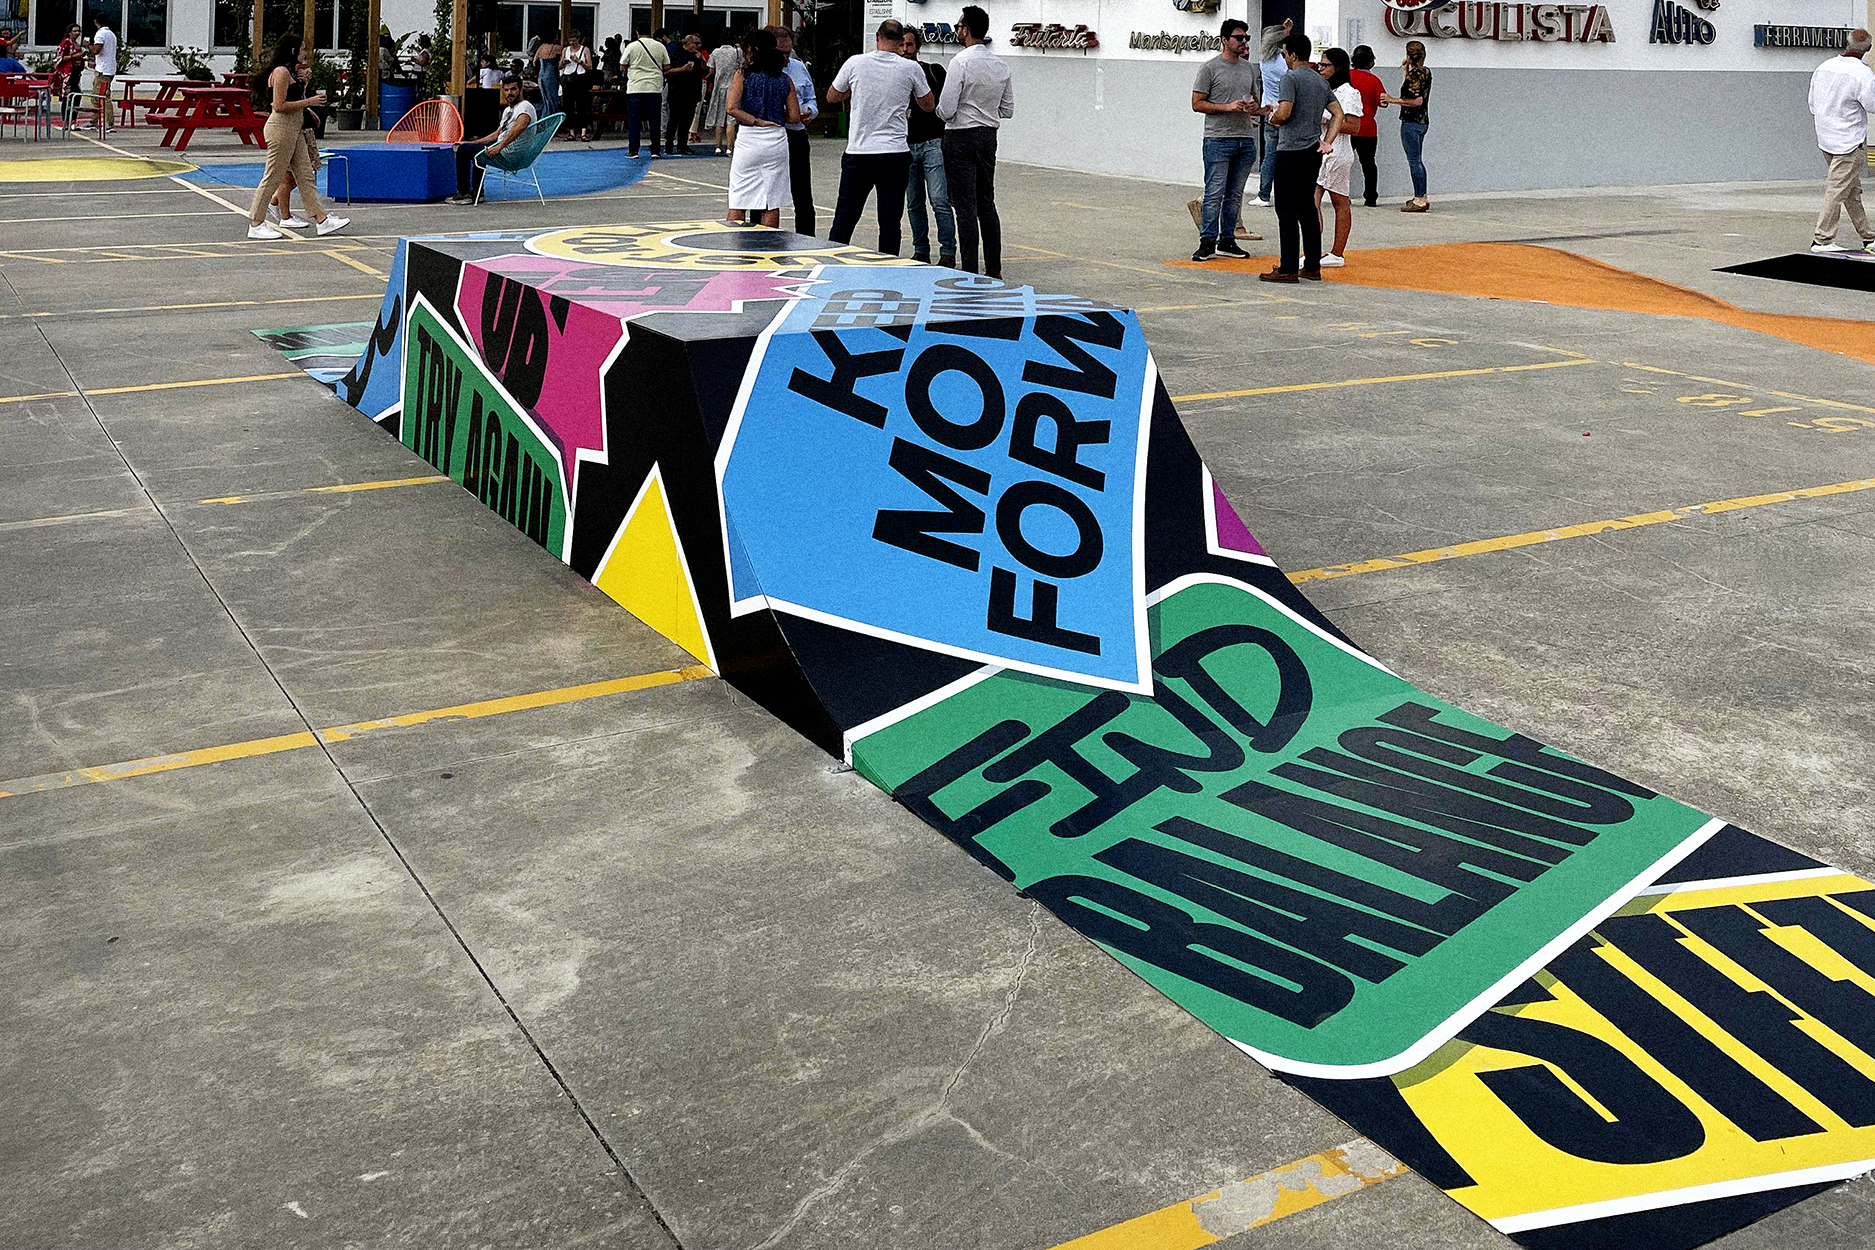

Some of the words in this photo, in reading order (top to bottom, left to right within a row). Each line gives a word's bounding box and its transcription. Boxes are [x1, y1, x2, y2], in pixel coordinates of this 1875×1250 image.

[1385, 0, 1617, 44] OCULISTA
[1765, 26, 1850, 48] FERRAMENT
[413, 326, 464, 478] TRY
[464, 387, 554, 550] AGAIN
